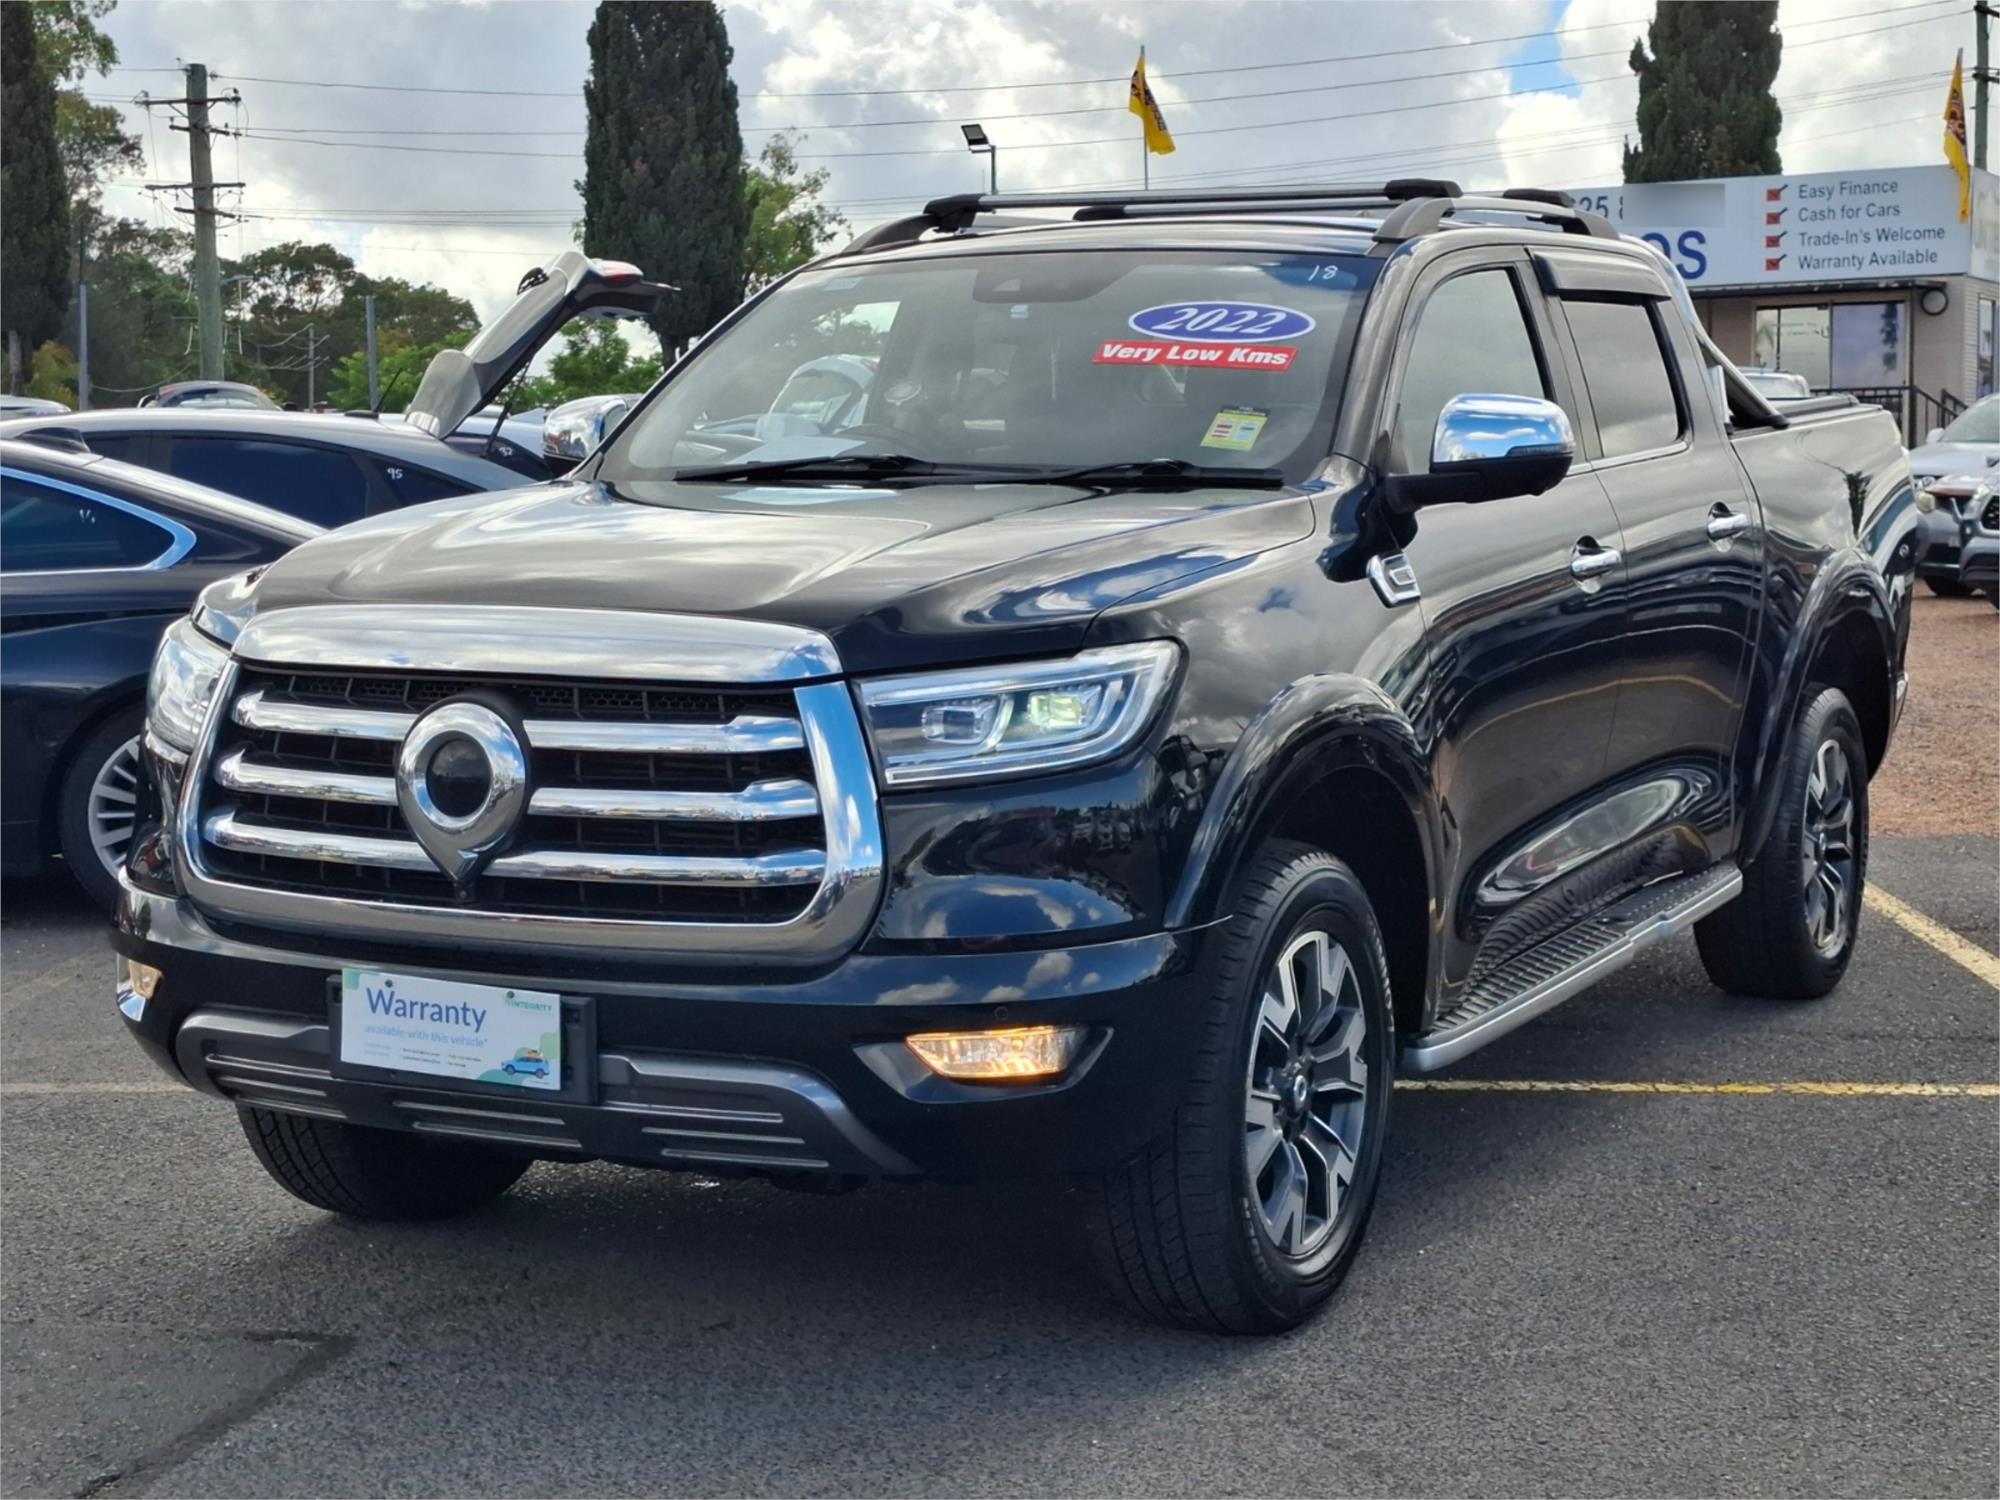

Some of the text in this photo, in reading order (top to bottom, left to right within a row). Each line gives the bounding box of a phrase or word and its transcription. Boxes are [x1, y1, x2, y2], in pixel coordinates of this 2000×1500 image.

[1798, 181, 1899, 200] Easy Finance
[1798, 202, 1901, 222] Cash for Cars
[1799, 226, 1946, 247] Trade-In's Welcome
[1798, 249, 1938, 270] Warranty Available
[1308, 265, 1338, 281] 18
[1151, 307, 1287, 333] 2022
[1102, 344, 1289, 365] Very Low Kms
[387, 467, 403, 480] 95
[366, 987, 487, 1033] Warranty
[365, 1025, 405, 1037] available
[408, 1029, 430, 1041] with
[431, 1031, 449, 1042] this
